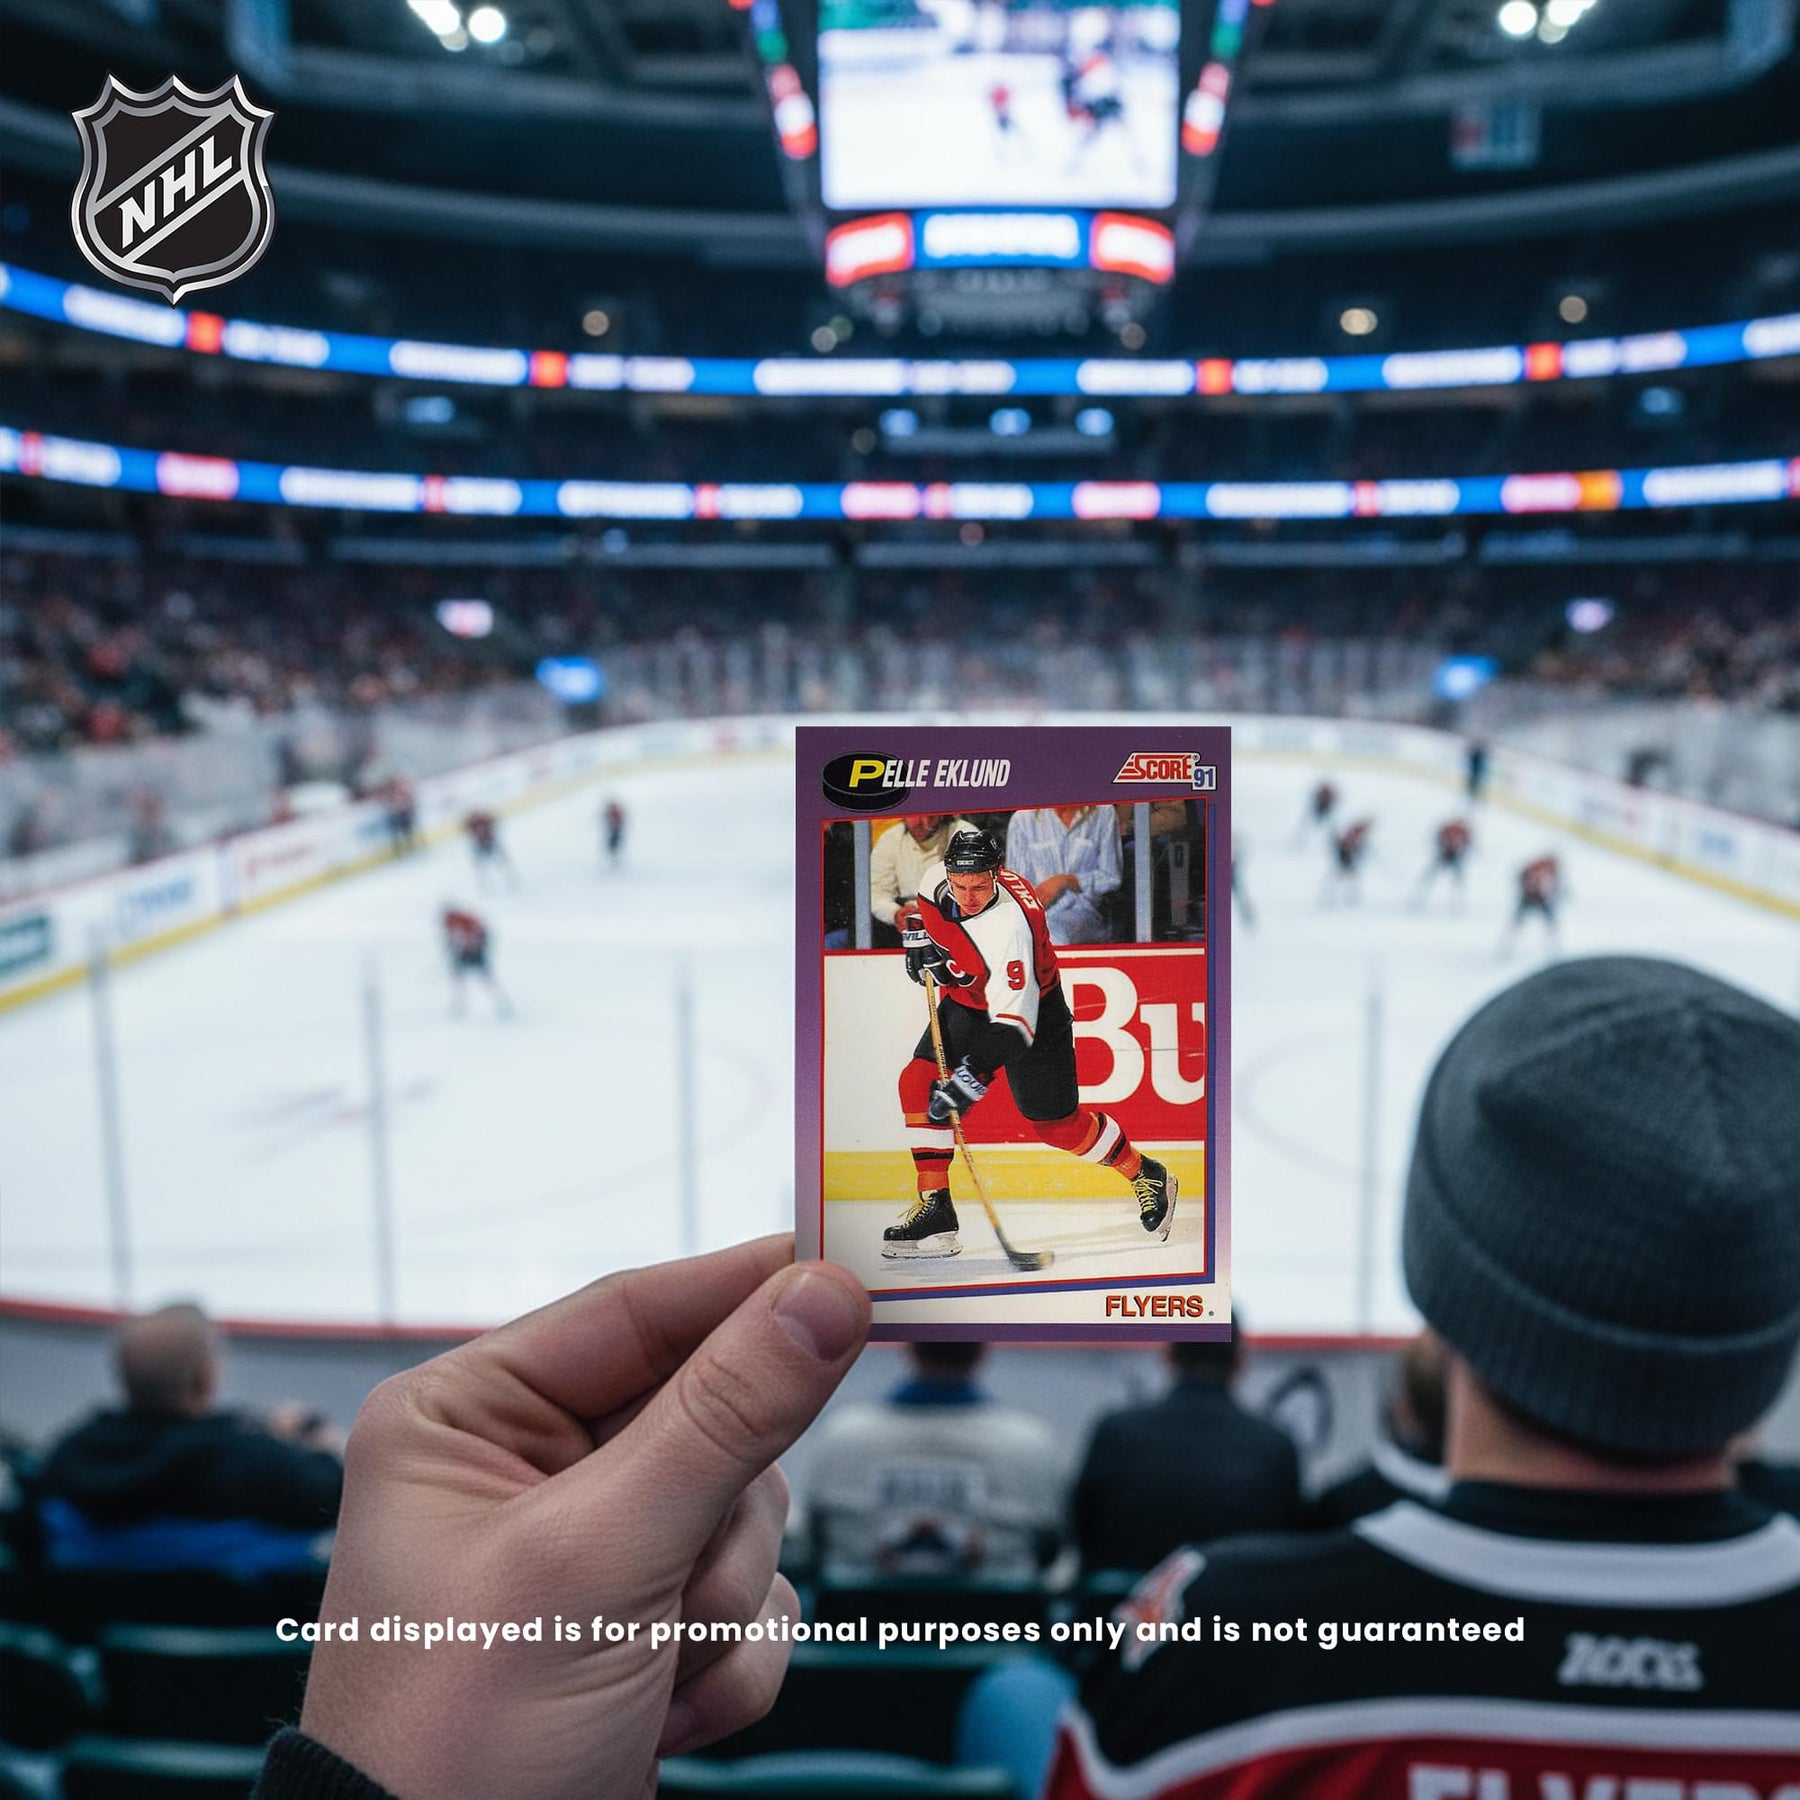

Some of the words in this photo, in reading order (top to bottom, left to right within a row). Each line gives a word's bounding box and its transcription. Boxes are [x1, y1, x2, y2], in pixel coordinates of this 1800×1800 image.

[849, 759, 931, 788] PELLE
[933, 759, 1011, 788] EKLUND
[1131, 754, 1193, 781] SCORE
[1193, 767, 1215, 788] 91
[1006, 959, 1026, 991] 9
[1105, 1295, 1204, 1318] FLYERS
